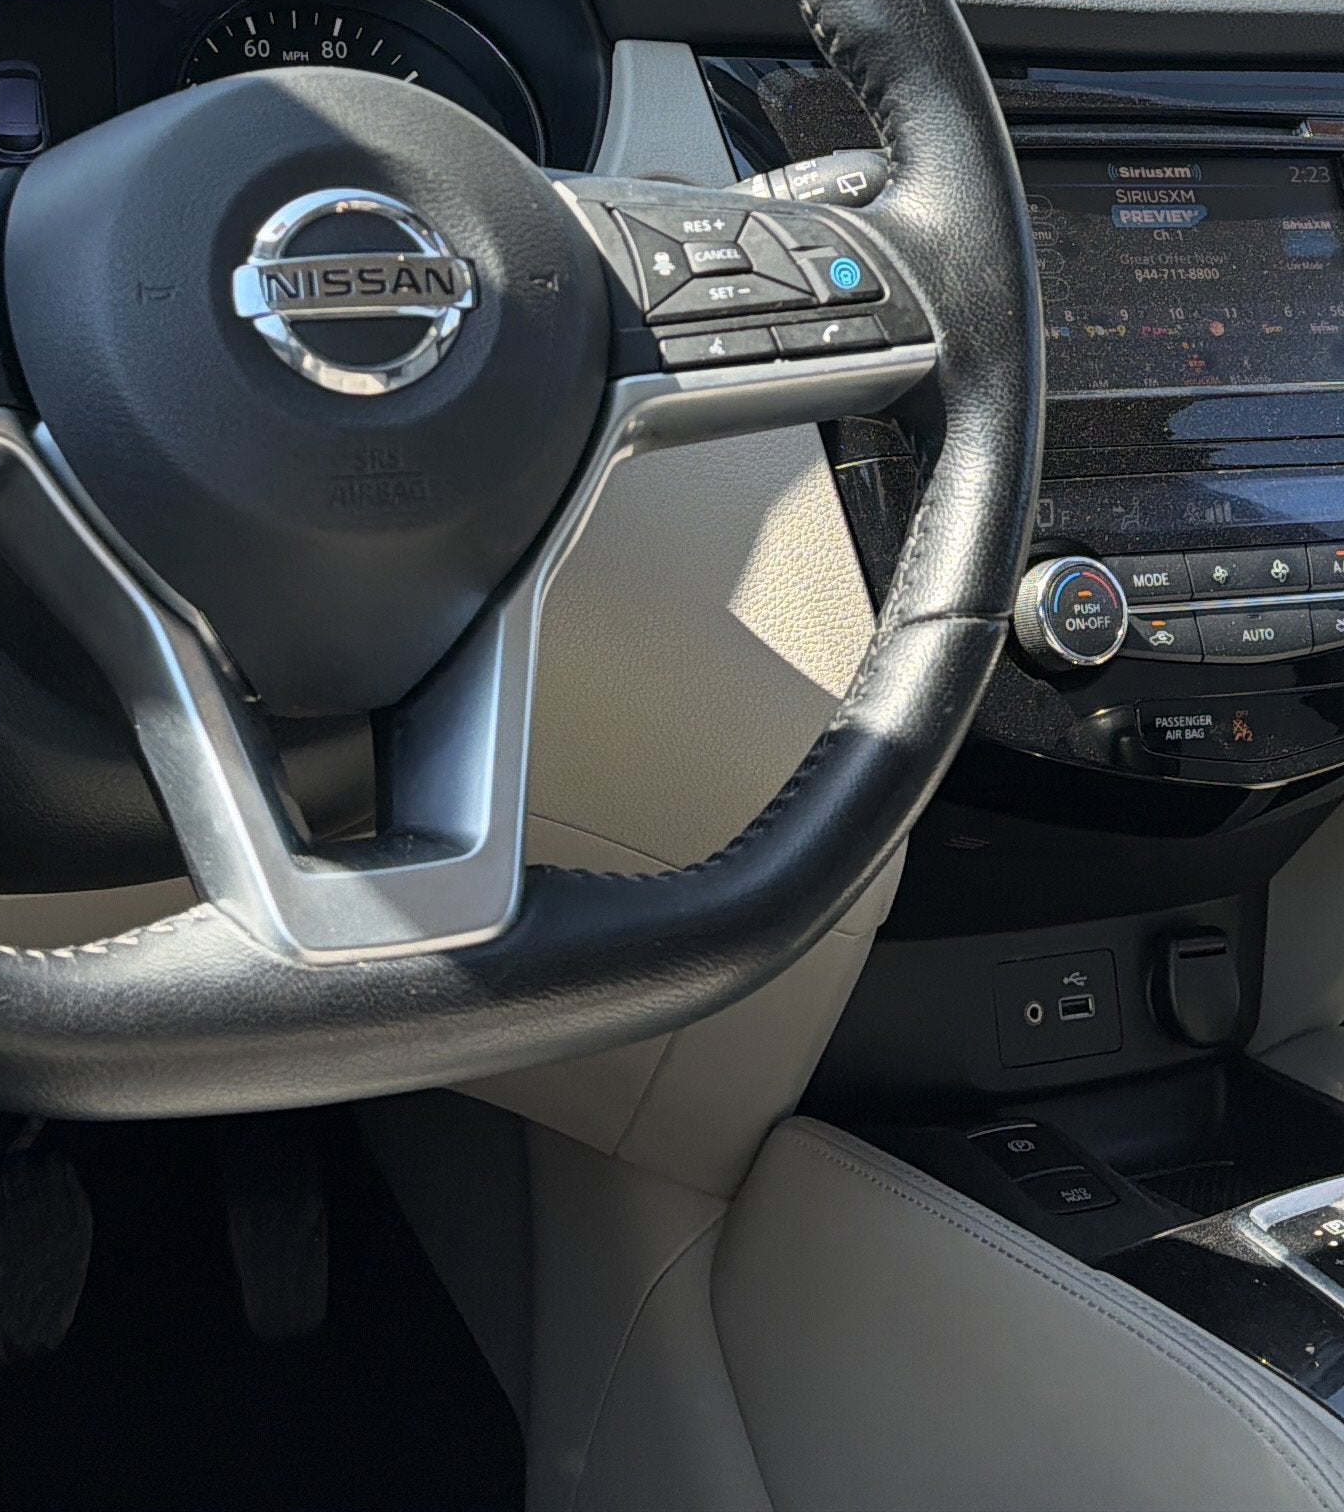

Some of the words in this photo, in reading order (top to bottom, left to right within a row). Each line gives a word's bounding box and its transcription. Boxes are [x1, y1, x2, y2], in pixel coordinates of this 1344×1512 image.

[244, 39, 271, 58] 60
[282, 50, 310, 63] MPH
[321, 40, 348, 59] 80
[792, 170, 819, 187] OFF
[1290, 166, 1331, 184] 2:23
[1115, 189, 1196, 204] SIRIUSXM
[1119, 208, 1199, 224] PREVIEW
[694, 248, 742, 263] CANCEL
[263, 266, 456, 301] NISSAN
[1119, 309, 1129, 321] 9
[1169, 308, 1184, 320] 10
[1133, 572, 1170, 588] MODE
[1074, 603, 1101, 615] PUSH
[1242, 627, 1275, 643] AUTO
[1155, 714, 1213, 729] PASSENGER
[1165, 728, 1183, 741] AIR
[1184, 727, 1205, 740] BAG
[1060, 1186, 1087, 1199] AUTO
[1064, 1192, 1092, 1204] HOLD
